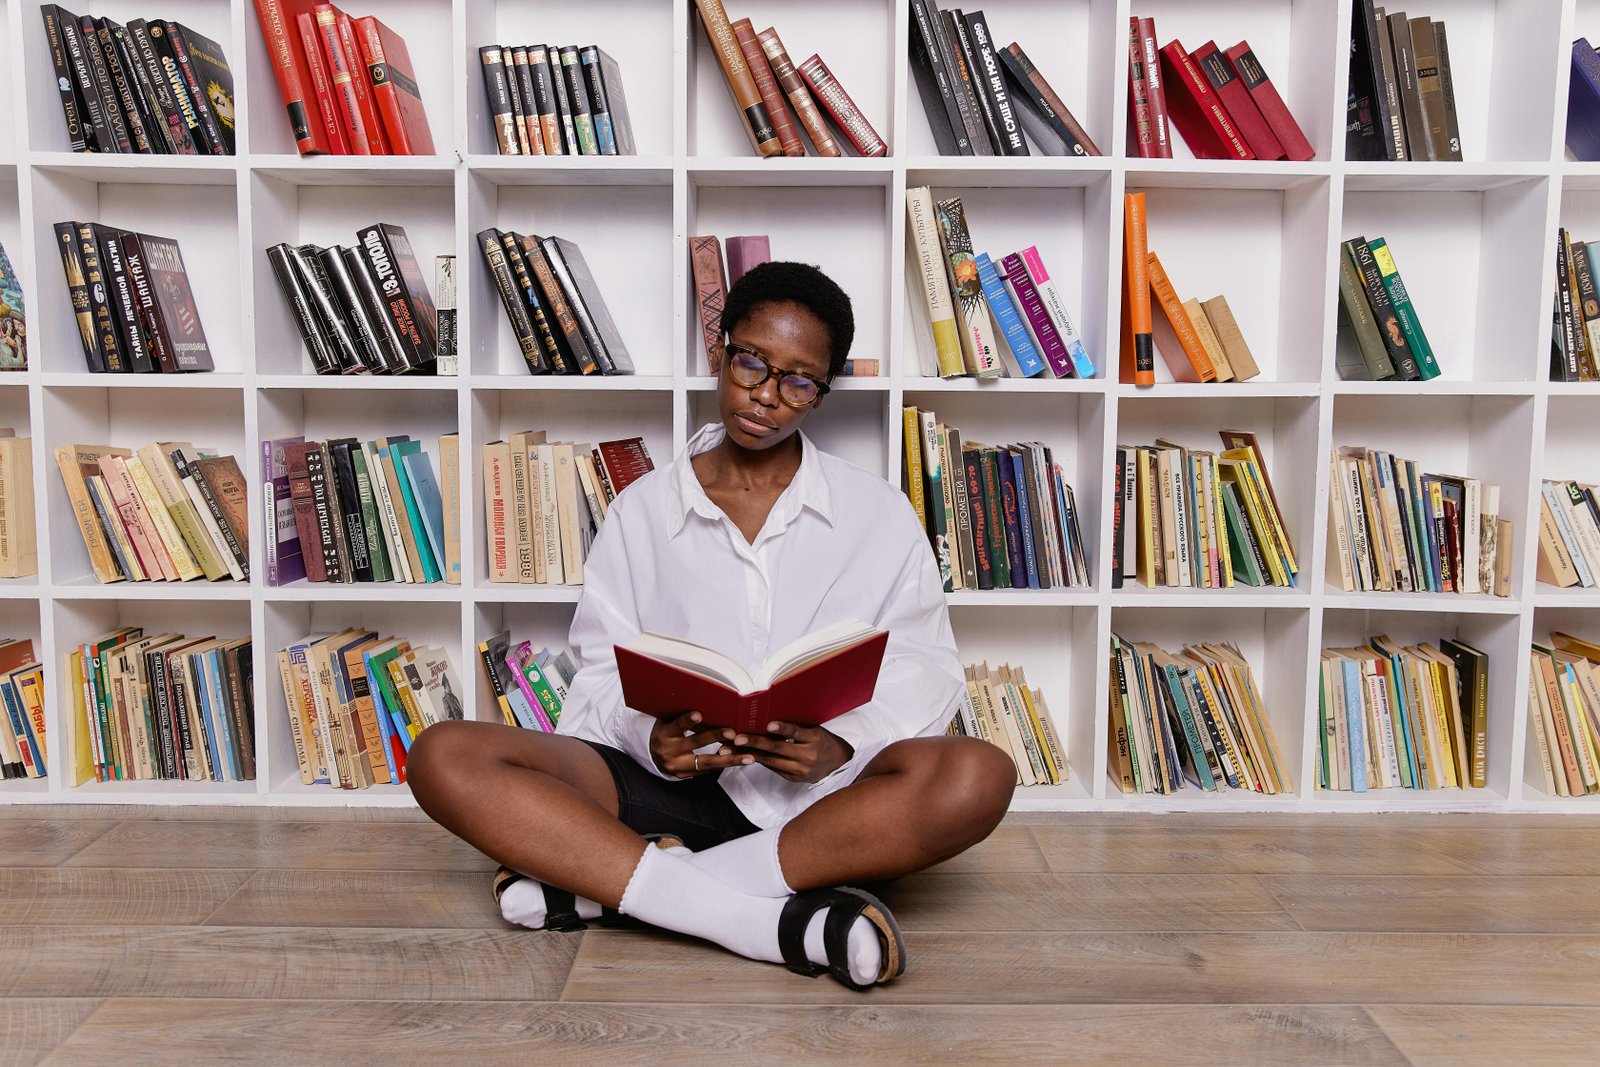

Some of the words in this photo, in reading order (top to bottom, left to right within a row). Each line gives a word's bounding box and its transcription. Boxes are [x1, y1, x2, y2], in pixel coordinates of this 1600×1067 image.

[46, 14, 59, 48] ЧИГИРИН
[65, 24, 82, 59] МУЗЫКЕ
[973, 22, 988, 46] 1989
[55, 49, 63, 67] Иван
[87, 33, 103, 66] ЭПОХА
[104, 43, 120, 73] ГЮГО
[277, 38, 292, 68] НОВЫЕ
[713, 23, 739, 75] ПАМЯТНИКИ
[981, 46, 998, 76] МОРЕ
[76, 58, 91, 89] ВЕРЬТЕ
[97, 67, 109, 83] ЕГО
[102, 84, 112, 93] И
[990, 75, 1003, 92] НА
[114, 73, 134, 111] ВИКТОР
[161, 54, 200, 130] РЕАНИМАТОР
[995, 92, 1007, 102] И
[65, 101, 79, 136] Отец
[105, 93, 126, 141] ПЛАТОН
[999, 101, 1017, 132] СУШЕ
[1039, 96, 1056, 119] Кактусы
[1008, 132, 1022, 150] НА
[912, 198, 928, 246] КУЛЬТУРЫ
[79, 226, 102, 283] ВЕРН
[107, 239, 123, 273] МАГИИ
[362, 229, 400, 292] Э.ТОПОЛЬ
[1356, 243, 1373, 267] 1981
[128, 254, 153, 308] ШАНТАЖ
[921, 250, 939, 310] ПАМЯТНИКИ
[115, 275, 136, 323] ЛЕЧЕБНОЙ
[390, 301, 401, 318] ЛИЦО
[397, 297, 412, 321] РОССИИ
[396, 316, 408, 336] ЧУЖОЕ
[408, 324, 422, 346] ЗАВТРА
[1055, 307, 1074, 337] будущей
[96, 305, 121, 370] ЖЮЛЬ
[128, 325, 144, 359] ТАЙНЫ
[533, 307, 566, 372] ЖЮЛЬ
[514, 455, 523, 468] НА
[313, 483, 325, 501] ГОД
[515, 468, 525, 494] СУШЕ
[967, 465, 979, 495] 69-70
[129, 491, 141, 511] МАКСИМ
[517, 503, 526, 517] НА
[955, 480, 969, 531] ПРОМЕТЕЙ
[1175, 485, 1183, 512] ПРАВИЛА
[316, 502, 332, 546] КРУГЛЫЙ
[492, 498, 505, 536] МОЛОДАЯ
[518, 517, 528, 542] МОРЕ
[494, 536, 507, 569] ГВАРДИЯ
[520, 548, 533, 578] 1986
[155, 656, 164, 688] ДЕТЕКТИВ
[158, 690, 168, 727] ПОЛЬСКИЙ
[301, 678, 316, 724] ХЕРСОНЕСА
[31, 705, 47, 734] РАБЫ
[291, 716, 301, 737] СЫН
[1181, 708, 1203, 755] ПРОМЕТЕЙ
[163, 728, 174, 773] СОВРЕМЕННЫЙ
[295, 737, 307, 765] ПОЛКА
[1117, 727, 1128, 757] нефть
[1475, 732, 1485, 759] КРИСТИ
[1475, 761, 1485, 781] АГАТА
